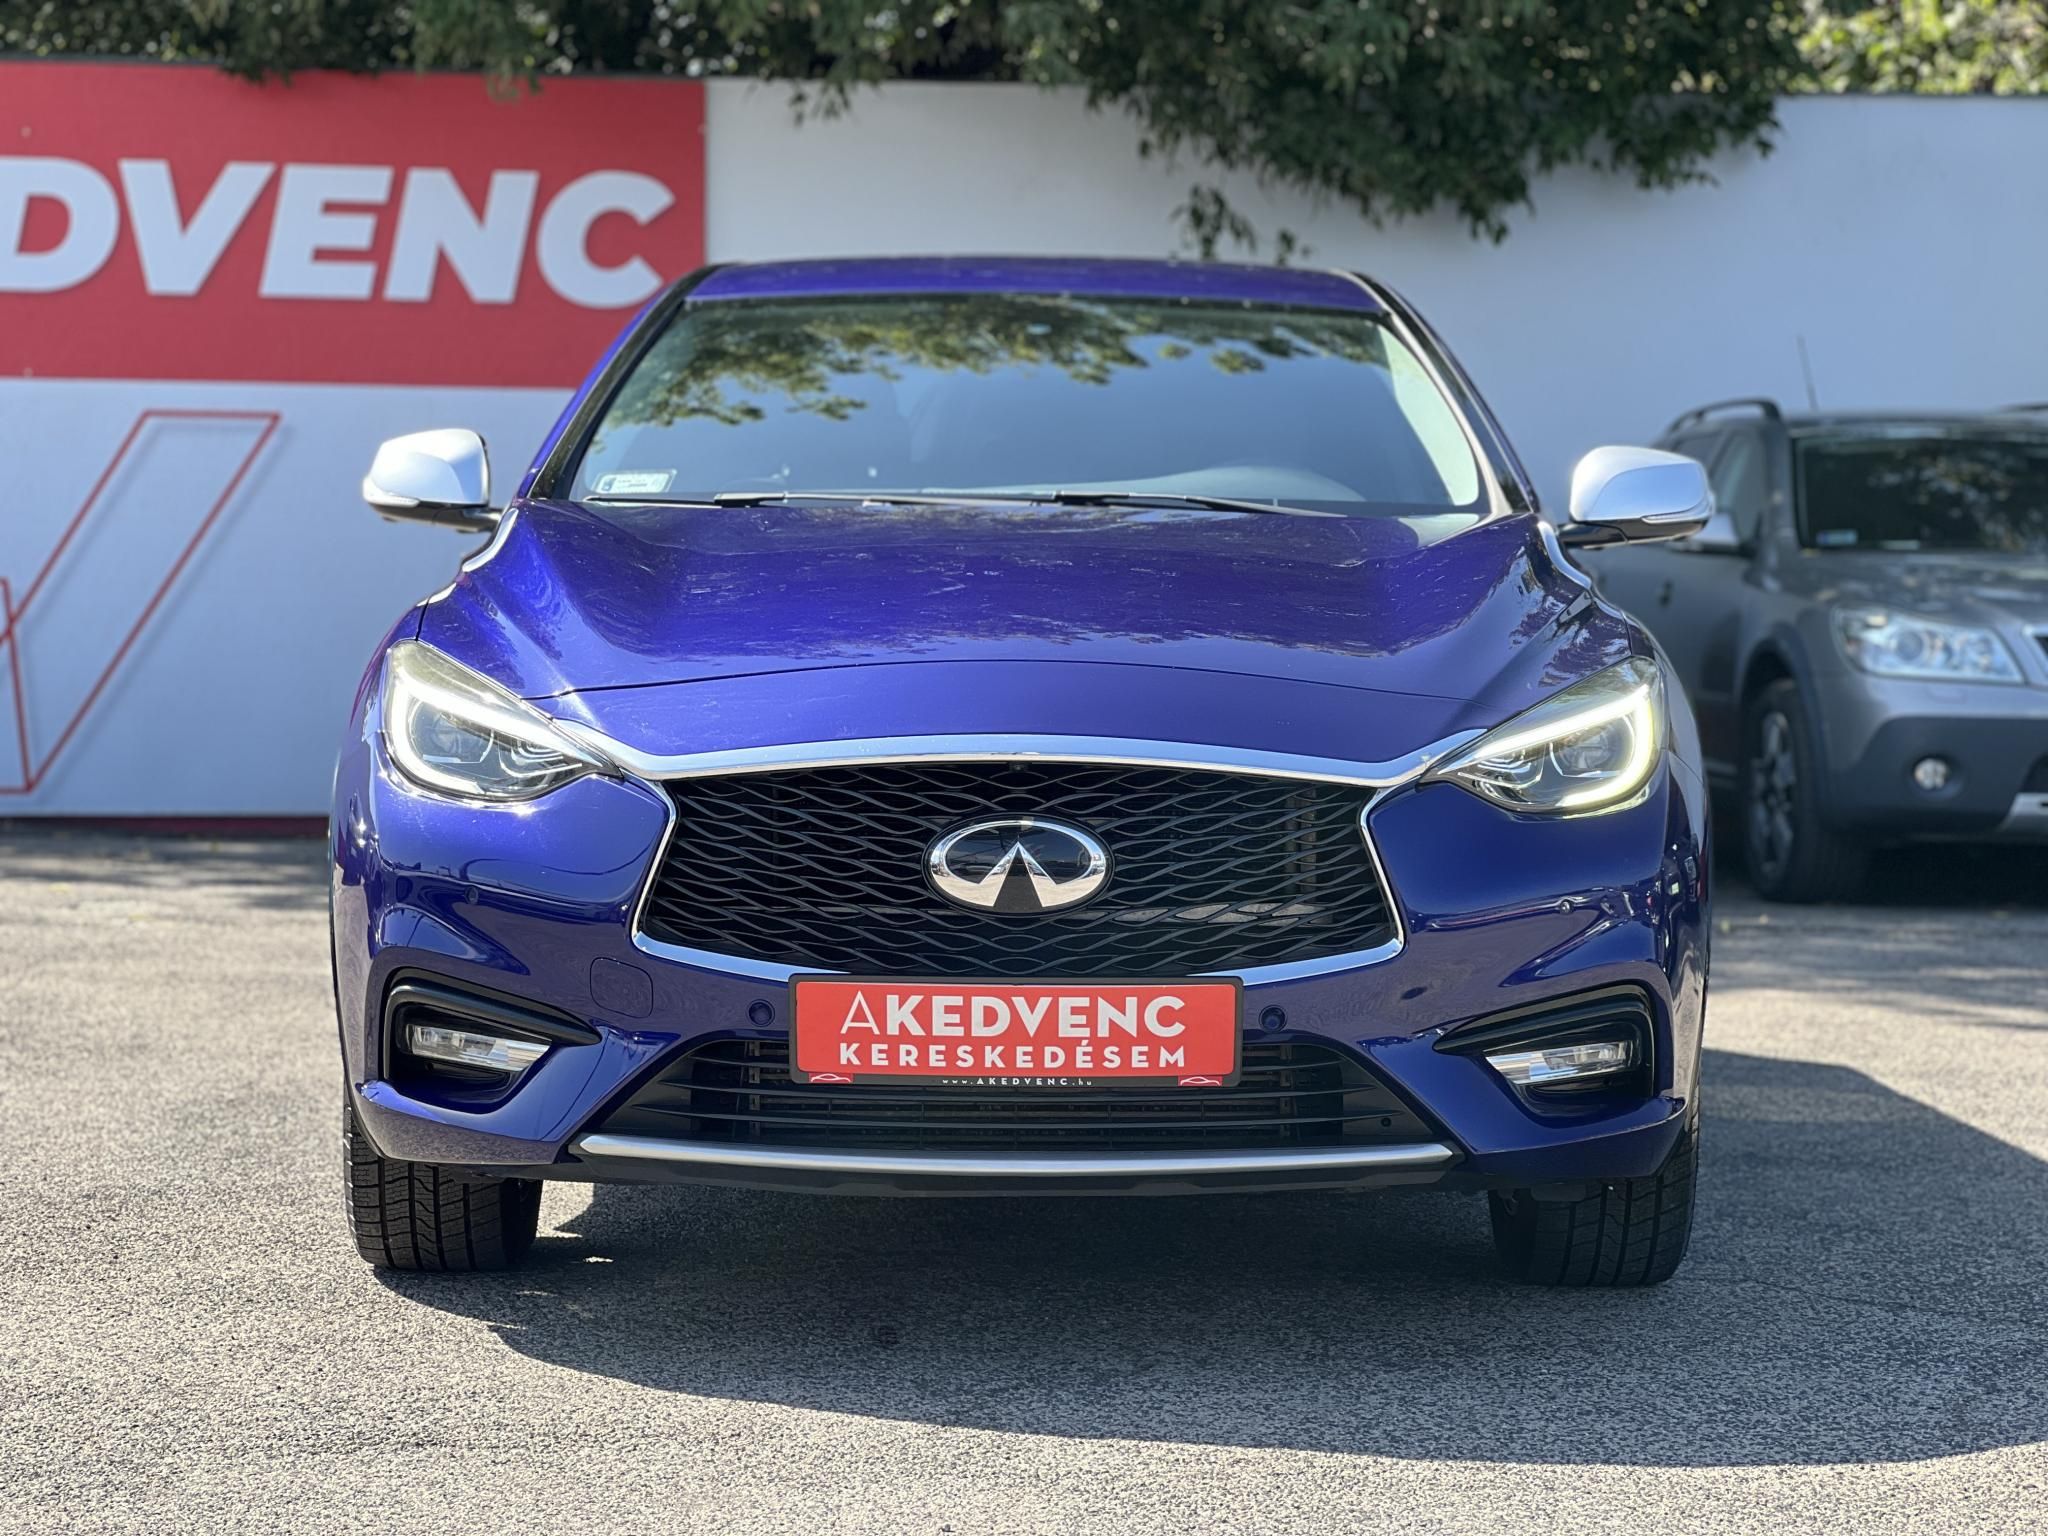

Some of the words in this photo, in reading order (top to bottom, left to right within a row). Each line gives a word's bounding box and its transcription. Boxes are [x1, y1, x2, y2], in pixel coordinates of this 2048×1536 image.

[0, 156, 675, 309] DVENC
[840, 1041, 1185, 1068] KERESKEDÉSEM
[942, 1077, 1092, 1086] www.AKEDVENC.hu
